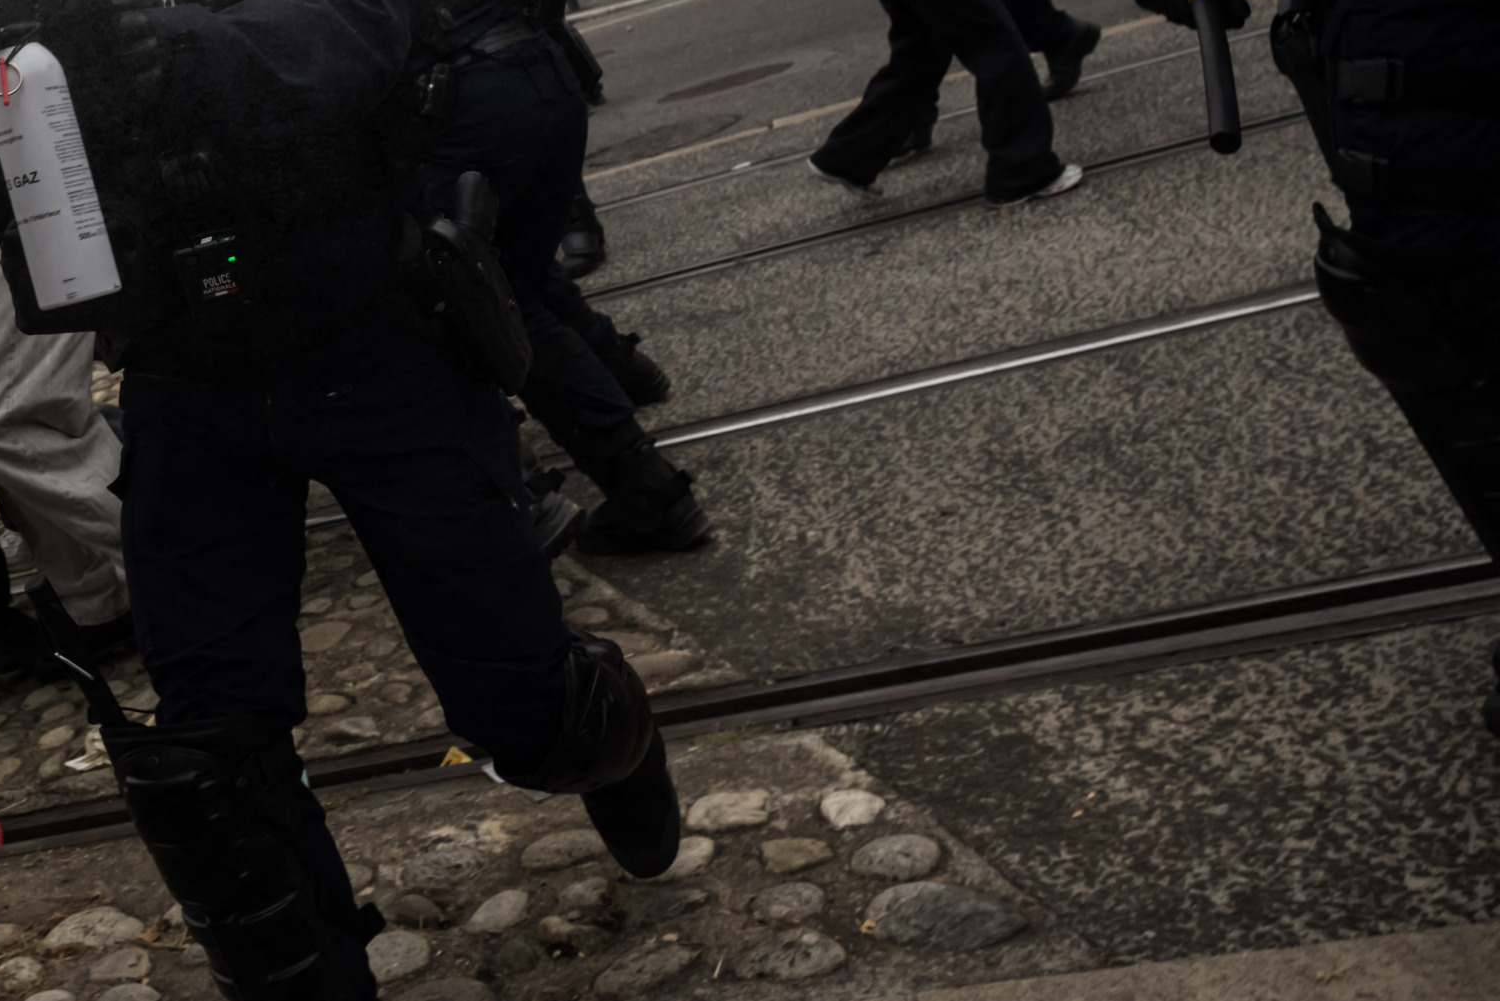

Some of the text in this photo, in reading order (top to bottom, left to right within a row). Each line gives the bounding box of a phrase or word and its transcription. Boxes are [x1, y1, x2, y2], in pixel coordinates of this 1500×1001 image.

[13, 169, 41, 189] GAZ
[202, 272, 232, 289] POLICE
[202, 281, 238, 295] NATIONALE
